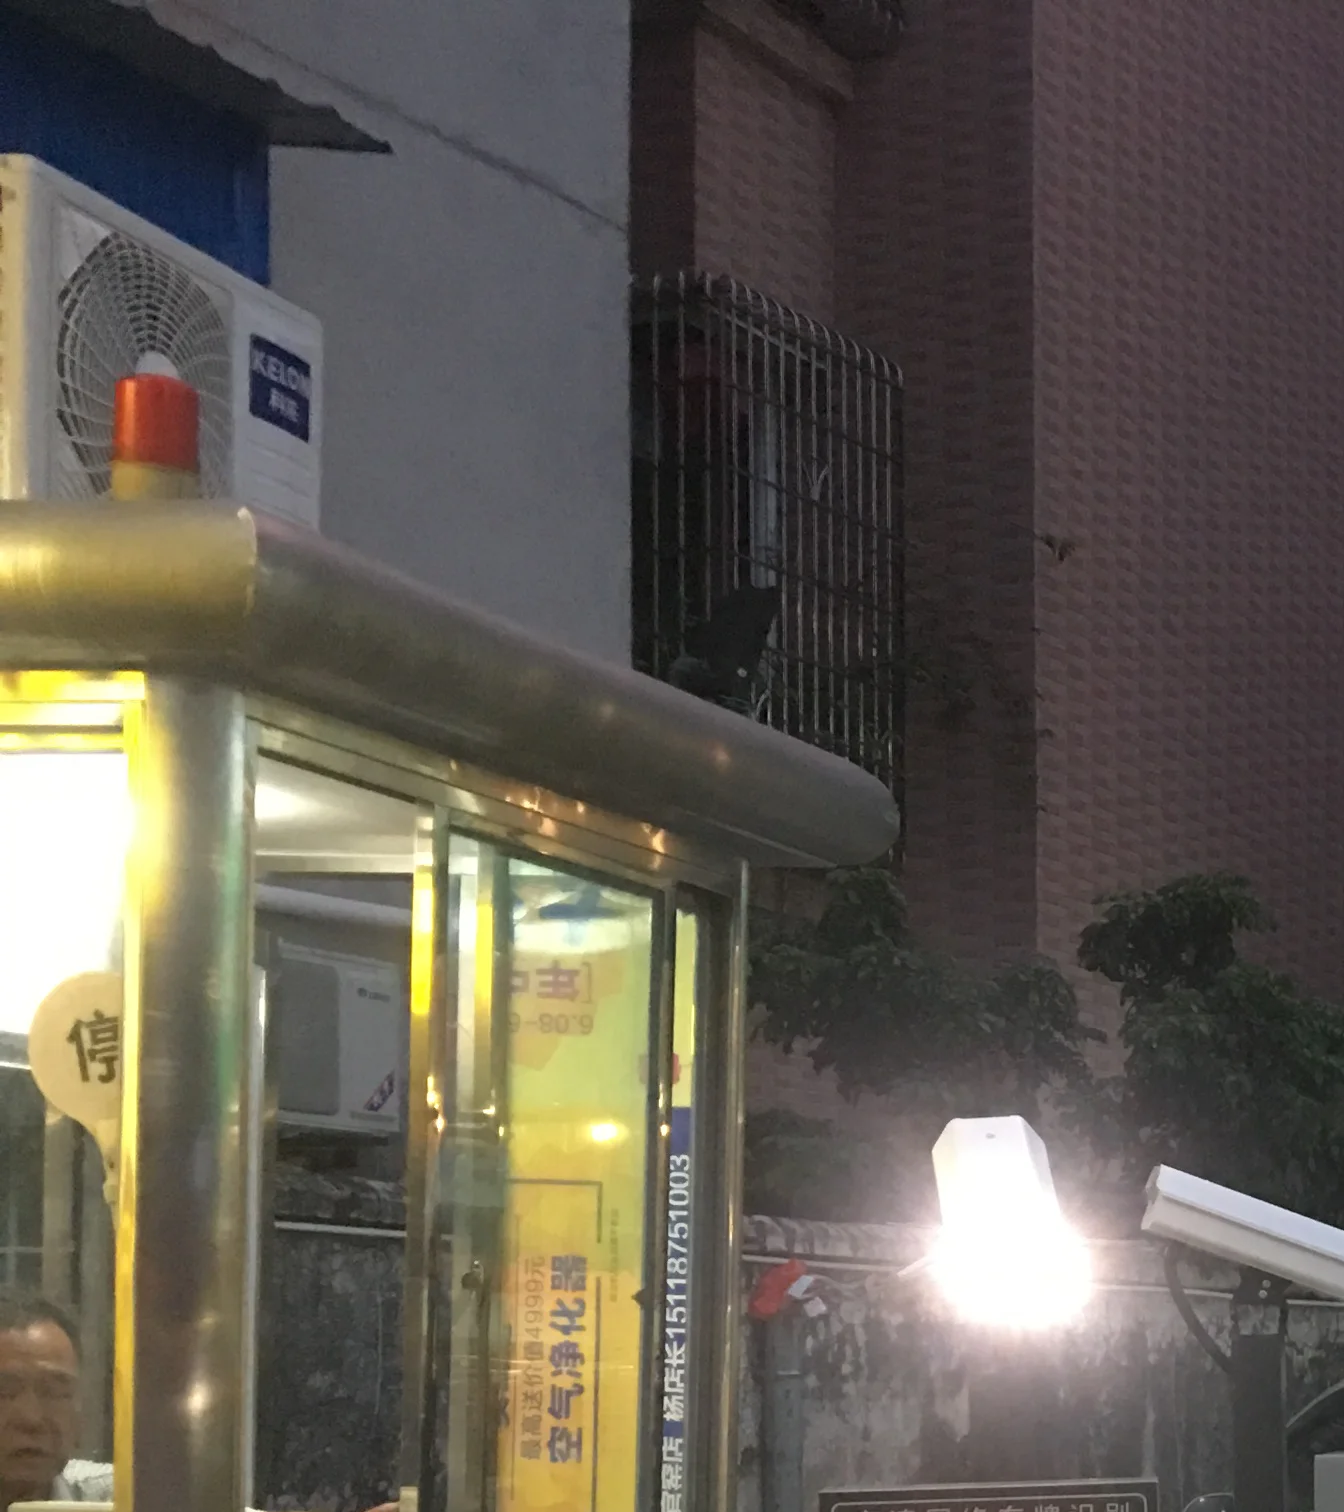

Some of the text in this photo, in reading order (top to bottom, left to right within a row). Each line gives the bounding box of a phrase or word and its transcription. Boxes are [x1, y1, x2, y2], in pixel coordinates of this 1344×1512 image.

[547, 1253, 588, 1465] 空气净化器
[663, 1153, 691, 1423] 杨店长15118751003
